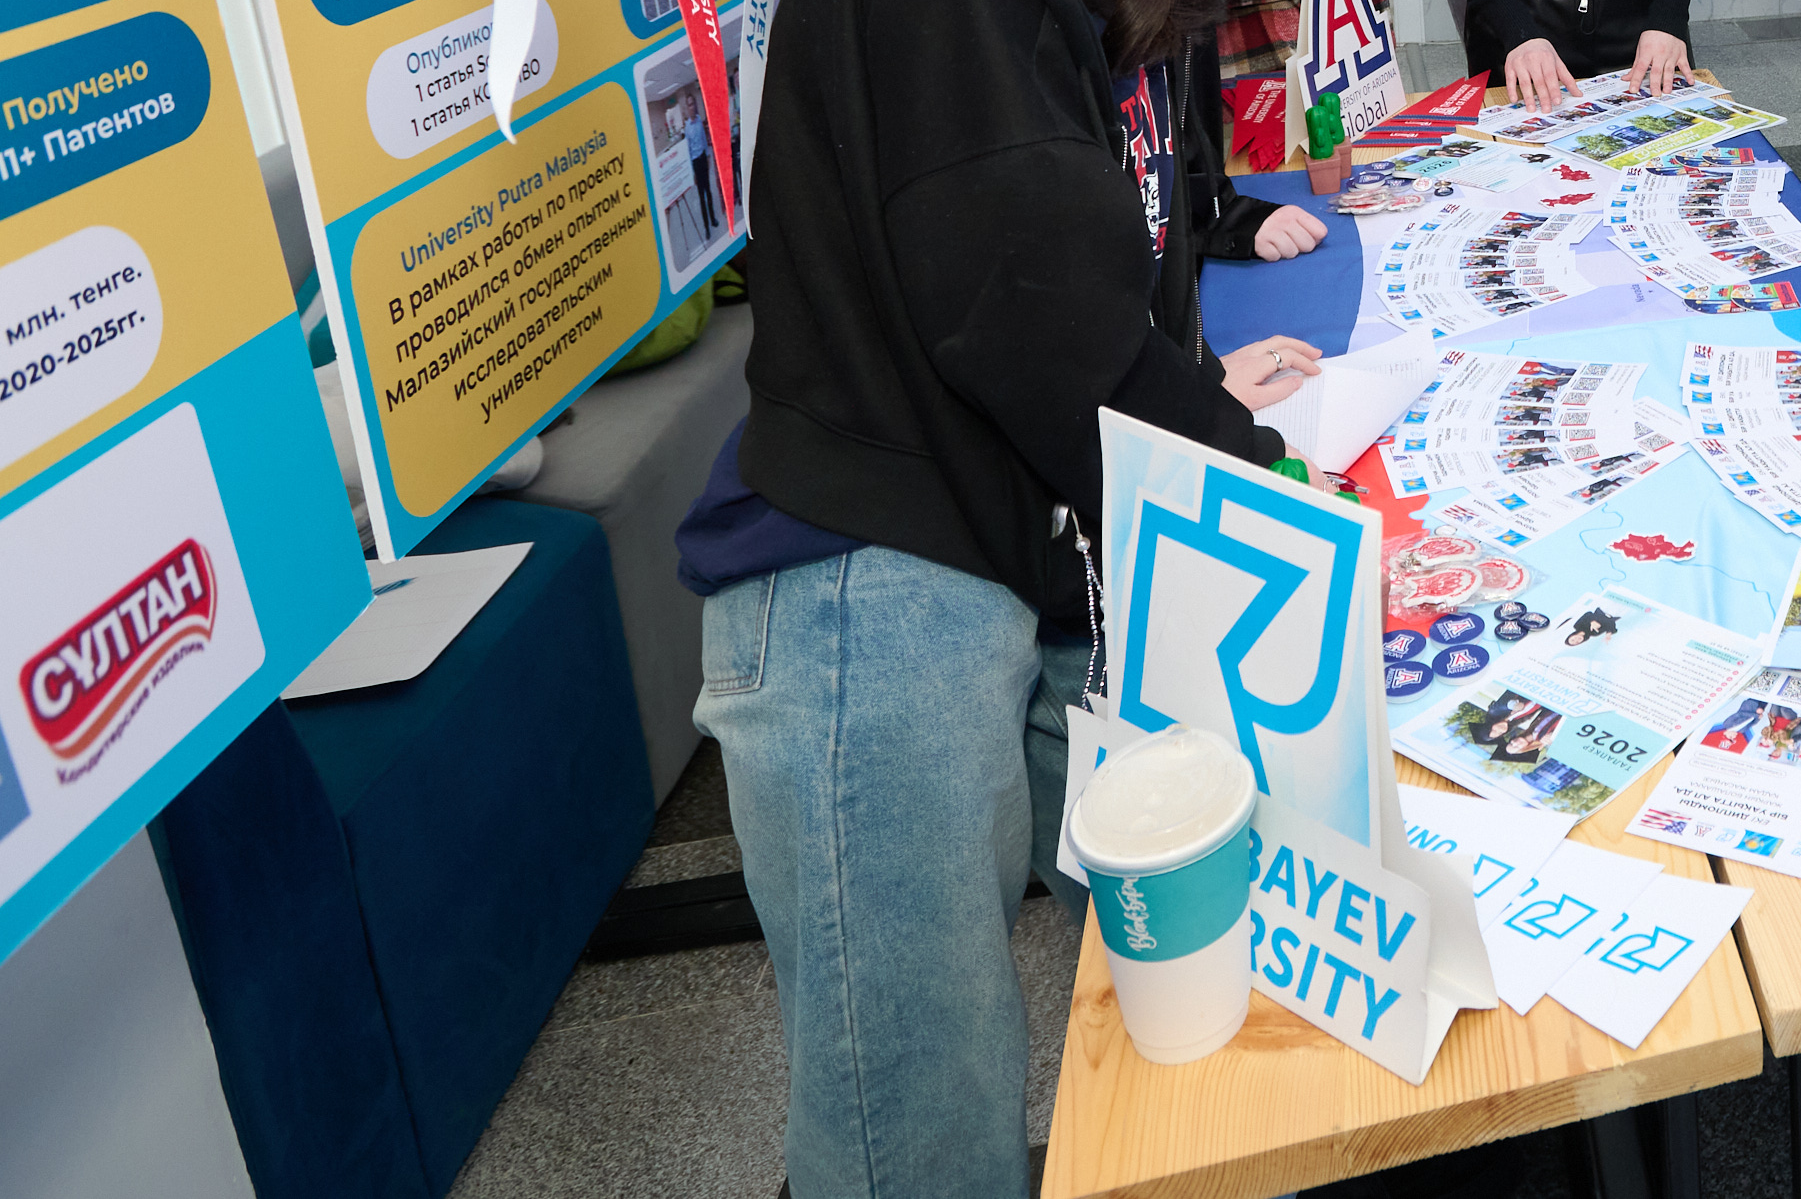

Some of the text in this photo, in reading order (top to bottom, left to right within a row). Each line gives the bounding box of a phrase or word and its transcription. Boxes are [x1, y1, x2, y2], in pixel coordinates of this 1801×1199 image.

[2, 60, 149, 132] Получено
[415, 63, 475, 104] 1 статья
[1362, 83, 1371, 96] OF
[1372, 68, 1397, 89] ARIZONA
[43, 92, 176, 163] Патентов
[411, 98, 471, 138] 1 статья
[400, 129, 608, 274] University Putra Malaysia
[388, 152, 625, 326] В рамках работы по проекту
[395, 181, 632, 364] проводился обмен опытом с
[1631, 283, 1646, 304] Nevada
[6, 266, 143, 346] млн. тенге.
[385, 204, 648, 413] Малазийский государственным
[454, 262, 613, 401] исследовательским
[0, 310, 146, 402] 2020-2025гг.
[481, 304, 604, 425] университетом
[1447, 662, 1481, 675] ARIZONA
[1503, 673, 1571, 708] KOZYBAYEV
[1513, 666, 1582, 699] UNIVERSITY
[57, 640, 205, 787] Кондитерские изделия
[1575, 722, 1648, 764] 2026
[1582, 745, 1633, 772] ТАЛАПКЕР
[1673, 785, 1789, 821] БІР УАҚЫТТА АЛ ДА,
[1679, 798, 1770, 826] ЕКІ ДИПЛОМДЫ
